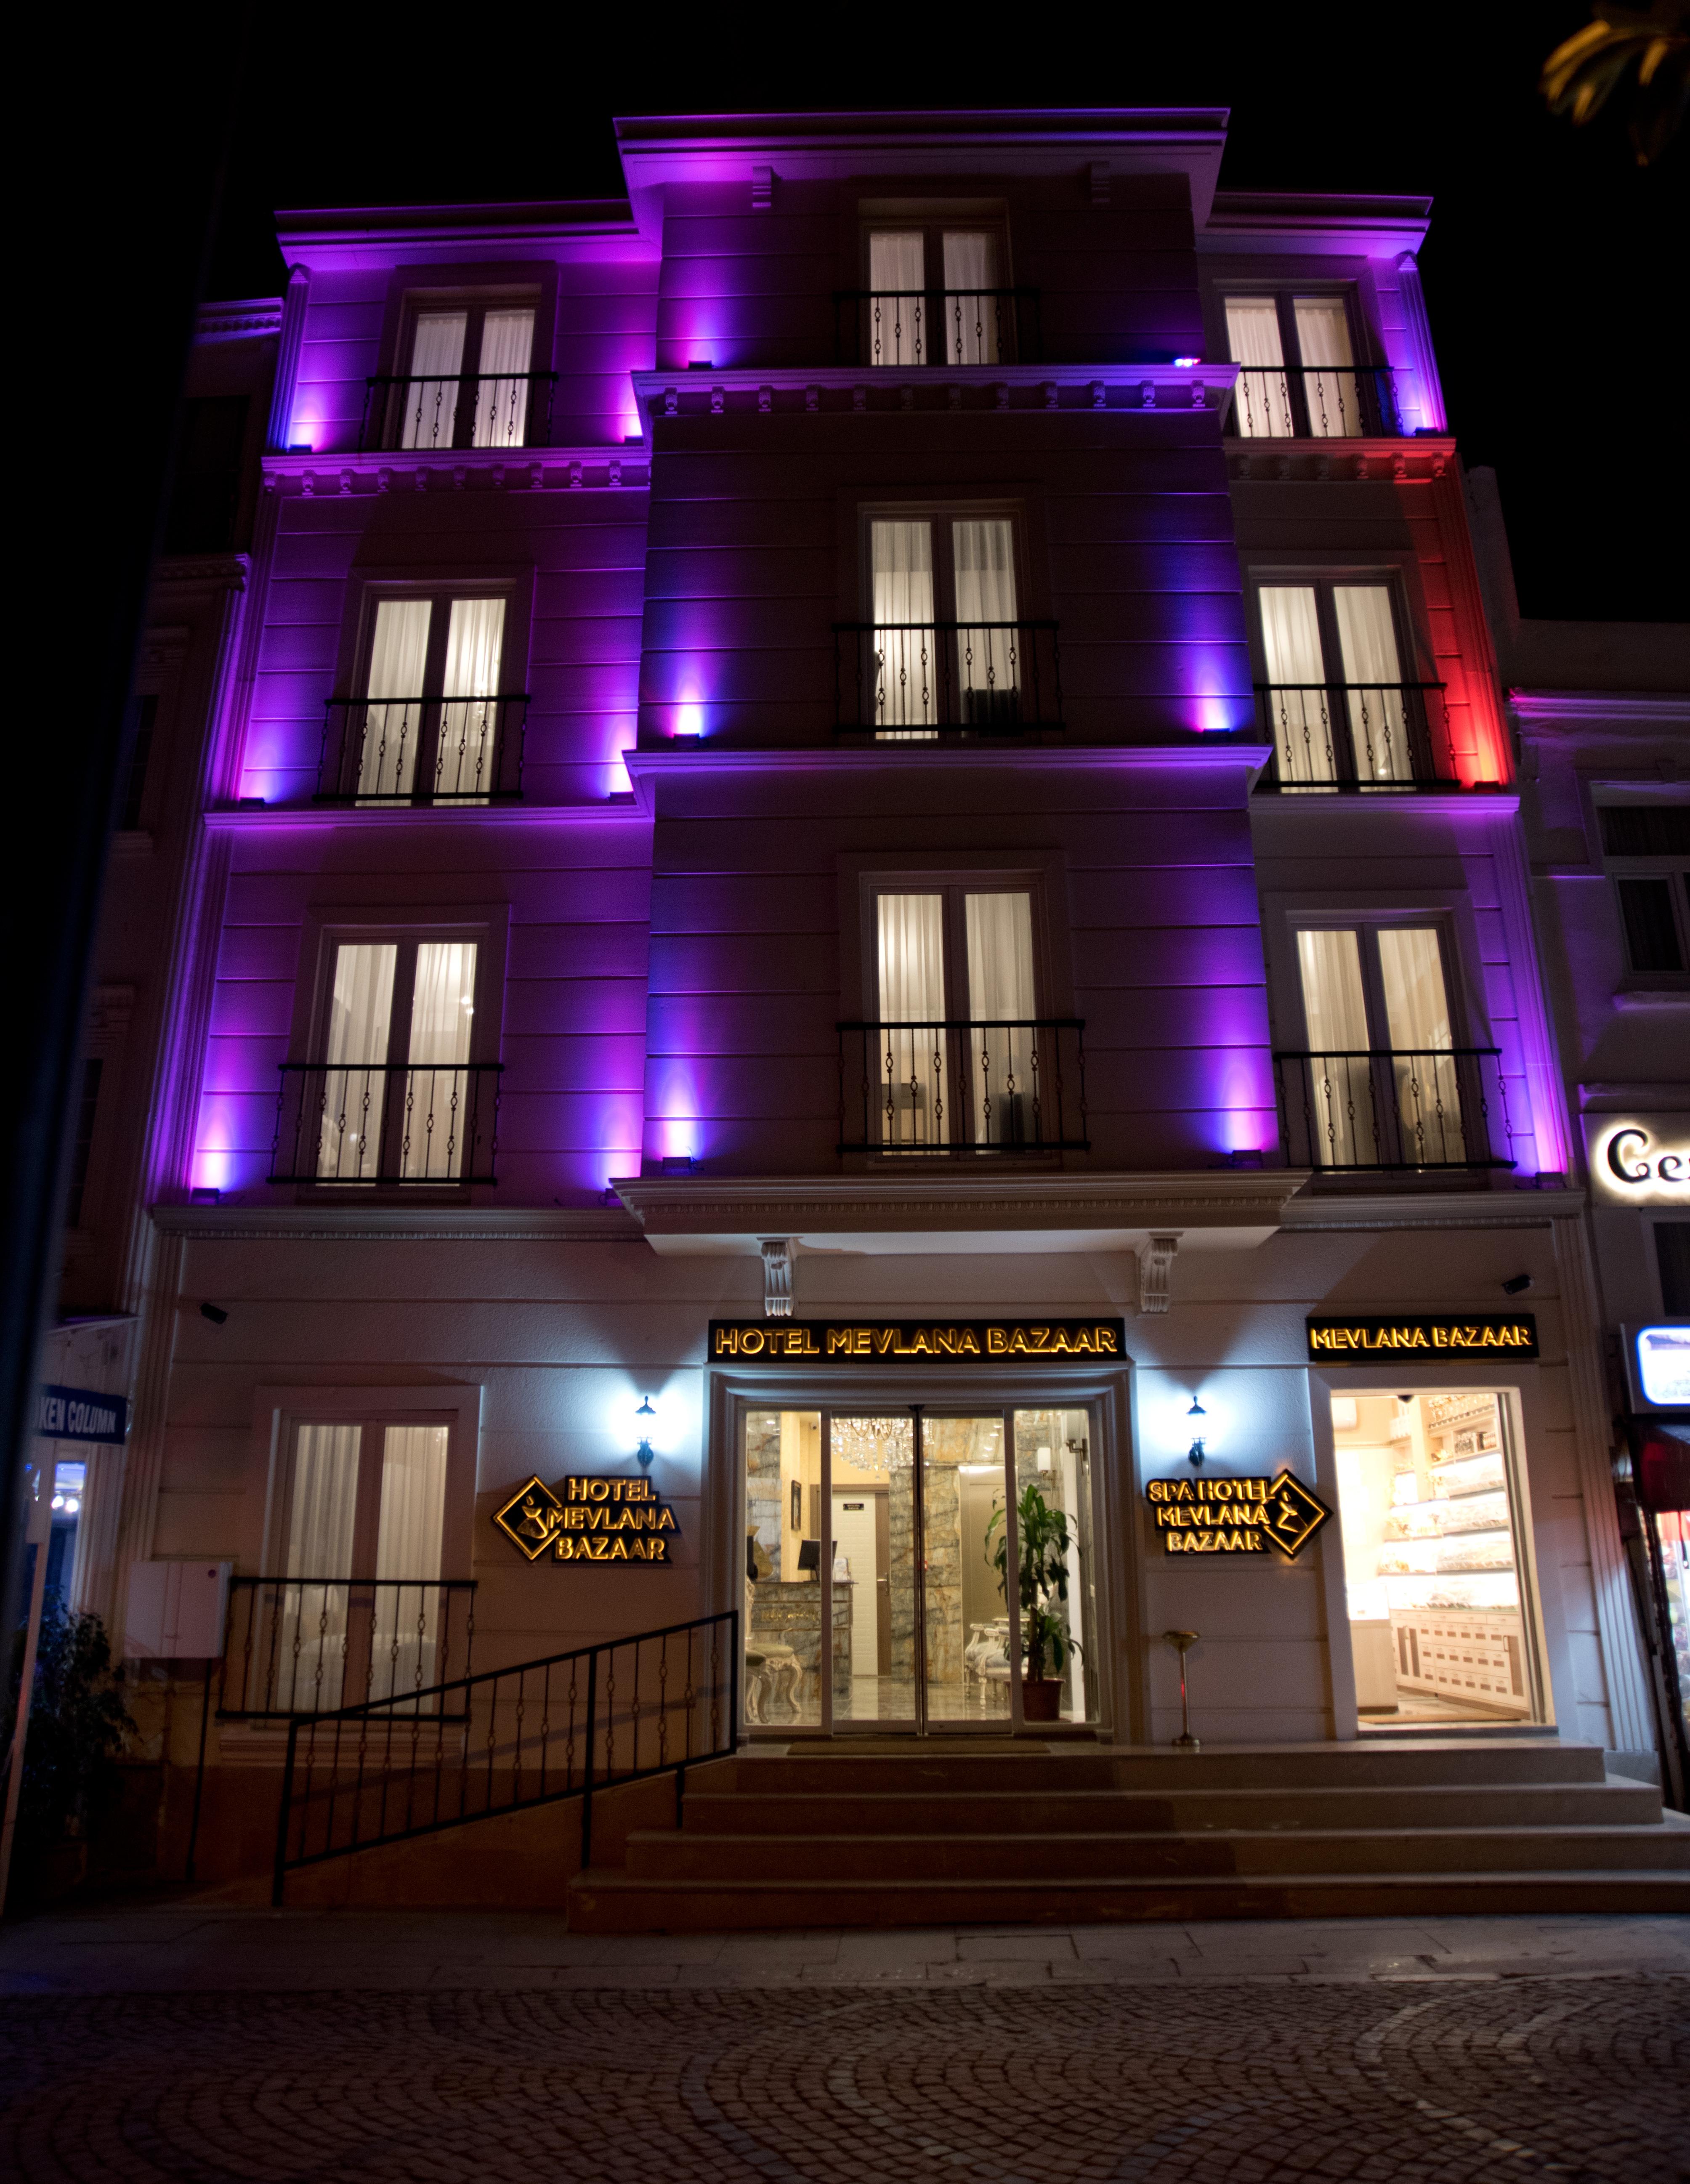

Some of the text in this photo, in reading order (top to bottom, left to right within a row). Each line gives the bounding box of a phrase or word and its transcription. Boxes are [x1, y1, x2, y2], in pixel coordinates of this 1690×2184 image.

[715, 1328, 1118, 1354] HOTEL MEVLANA BAZAAR
[1310, 1326, 1533, 1349] MEVLANA BAZAAR
[68, 1400, 116, 1433] COLUMN
[568, 1477, 656, 1501] HOTEL
[1148, 1479, 1276, 1502] SPA HOTEL
[547, 1505, 675, 1530] MEVLANA
[1156, 1504, 1271, 1527] MEVLANA
[555, 1536, 665, 1560] BAZAAR
[1167, 1530, 1264, 1552] BAZAAR
